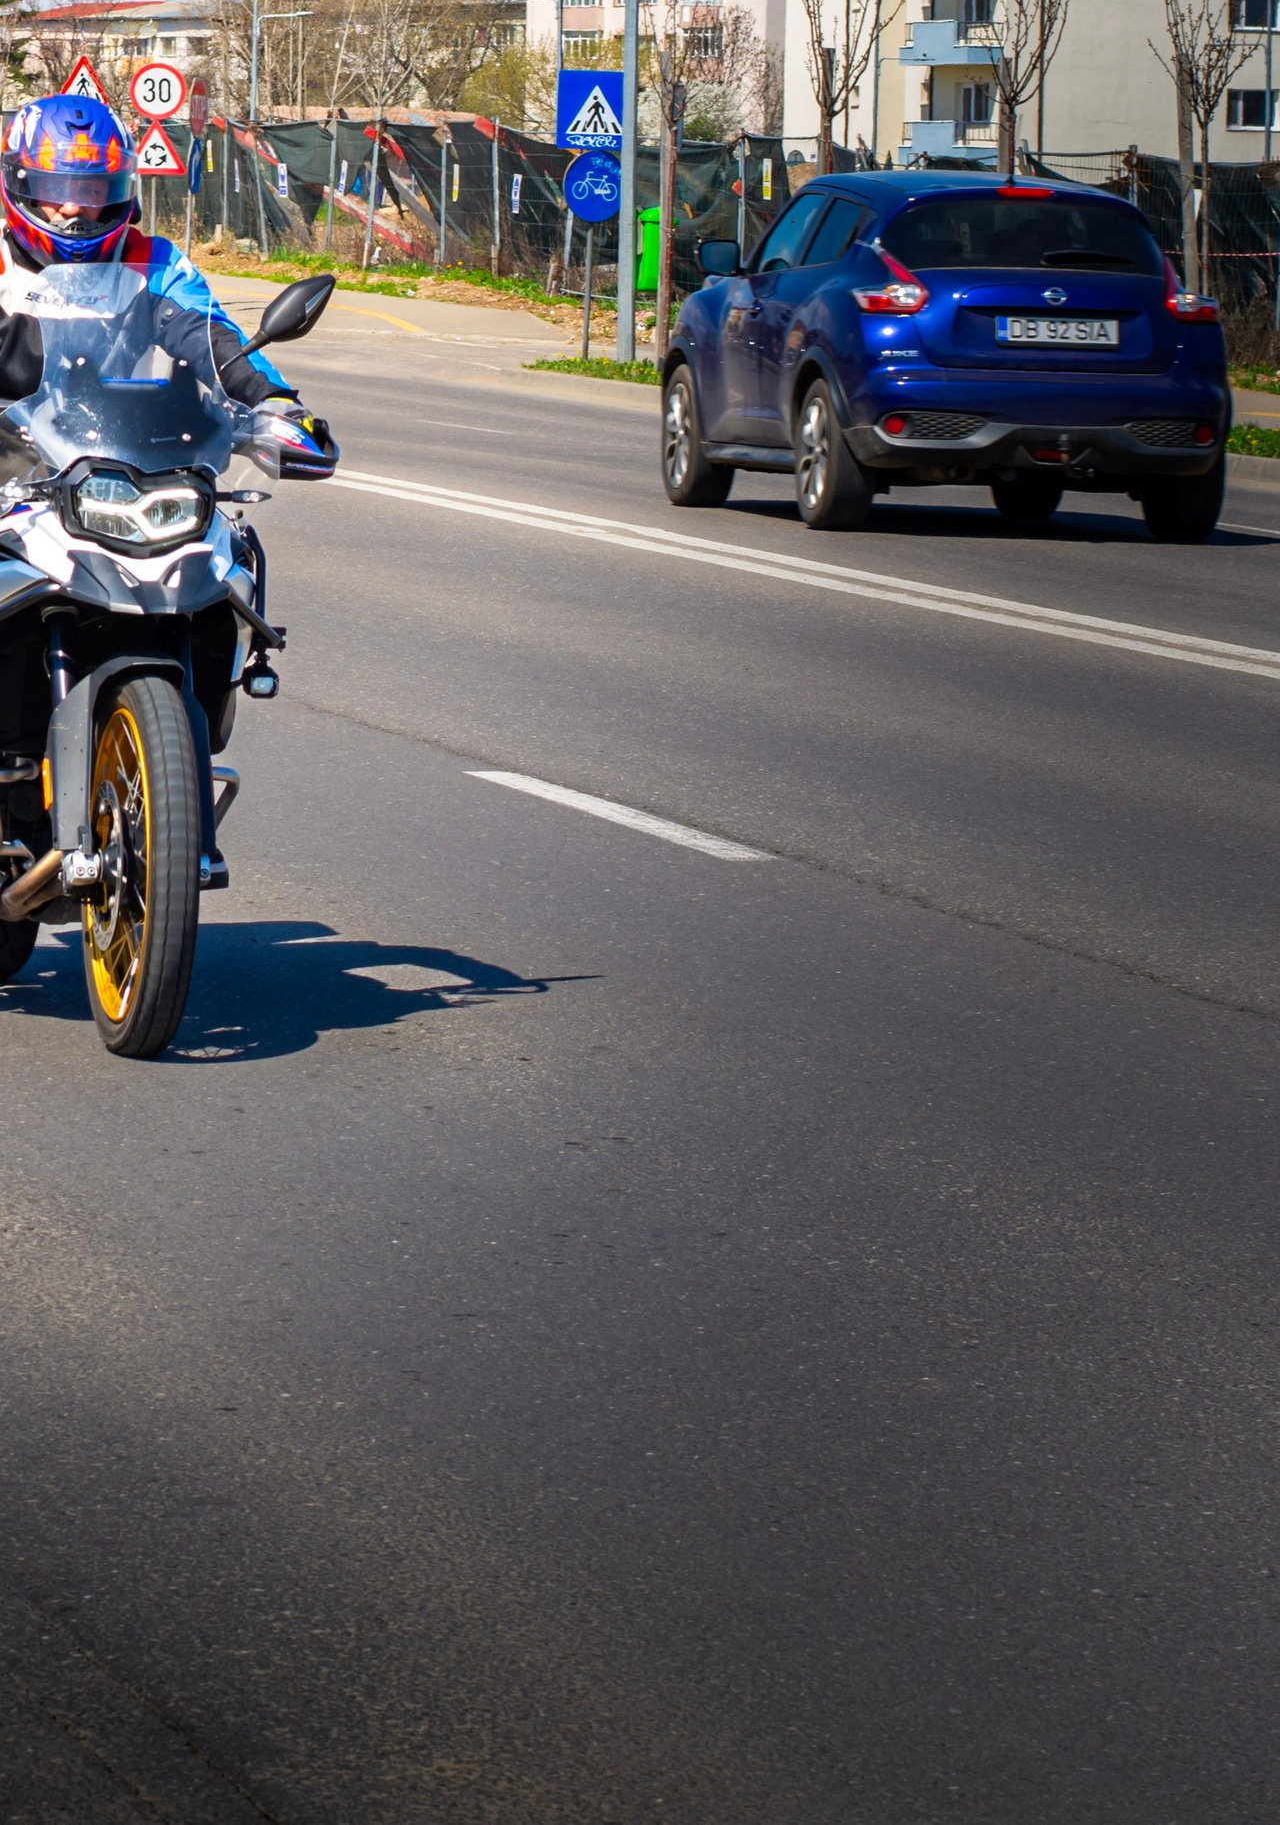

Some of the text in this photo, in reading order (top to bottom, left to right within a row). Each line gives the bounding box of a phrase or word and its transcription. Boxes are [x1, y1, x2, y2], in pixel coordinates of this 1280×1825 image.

[142, 78, 171, 103] 30
[1010, 319, 1112, 342] DB 92 SIA
